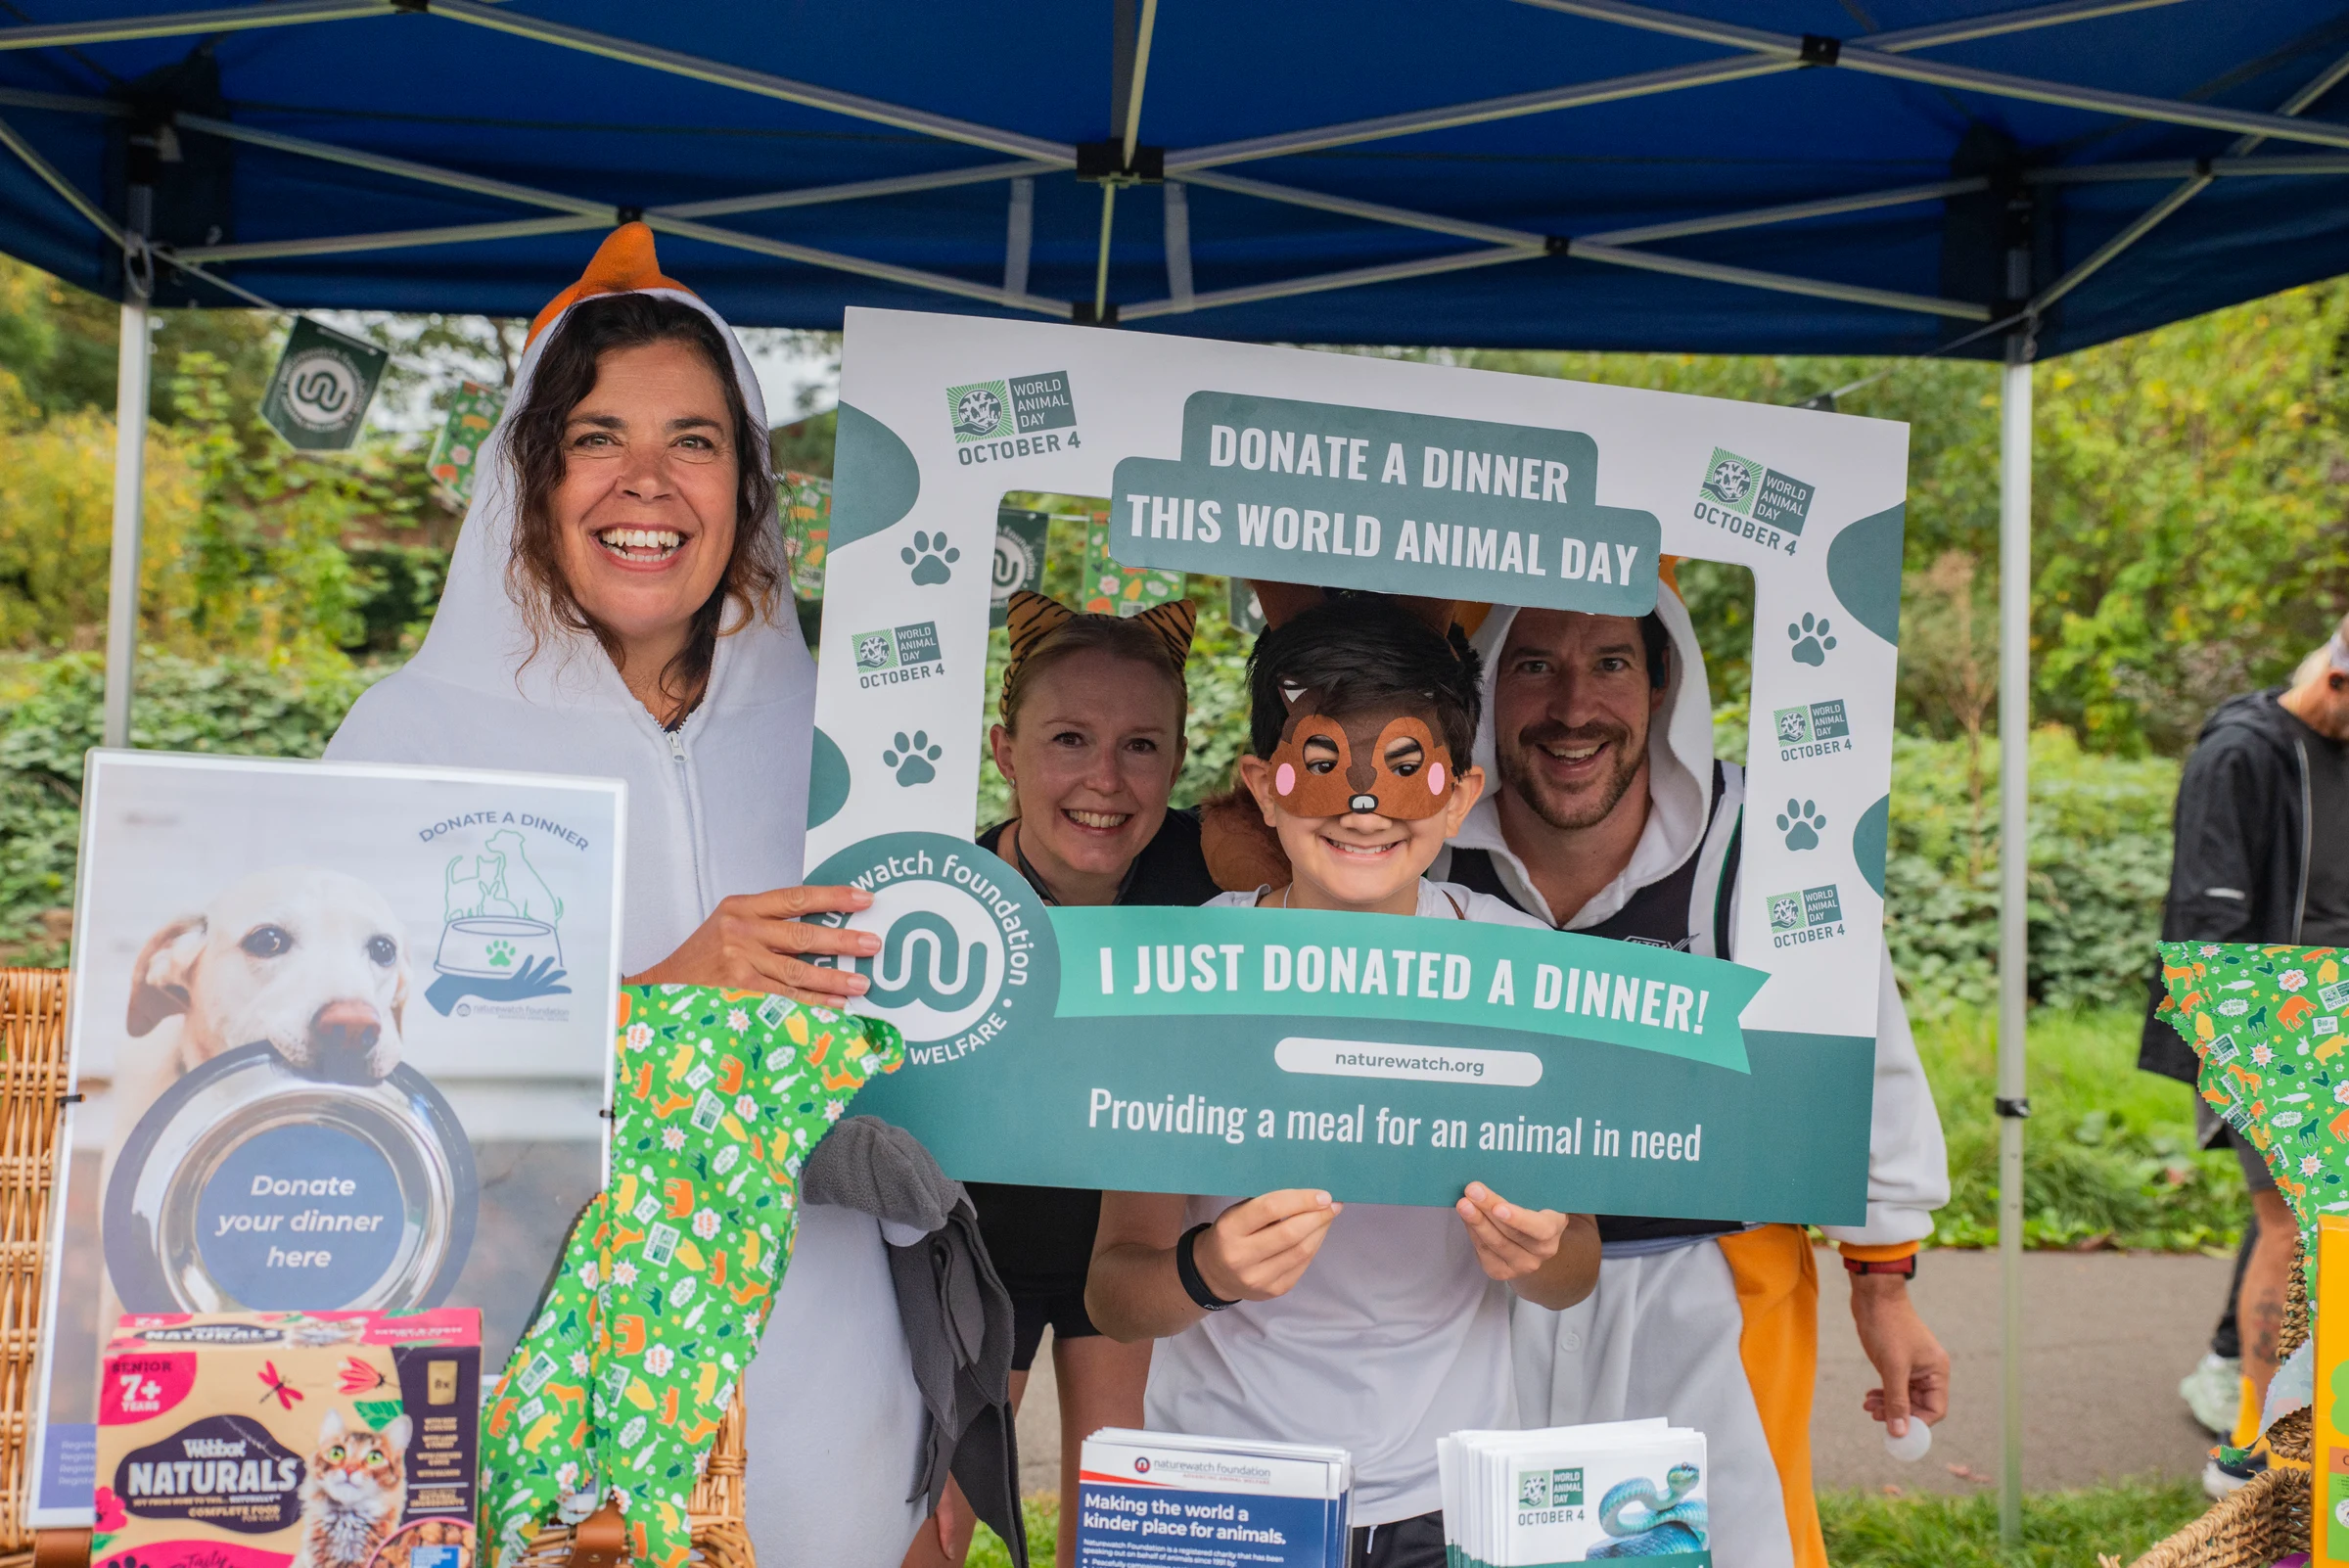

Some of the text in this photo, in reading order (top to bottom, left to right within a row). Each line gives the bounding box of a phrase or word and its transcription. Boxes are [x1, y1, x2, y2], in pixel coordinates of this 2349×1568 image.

[1014, 379, 1061, 396] WORLD
[1018, 394, 1069, 412] ANIMAL
[1021, 413, 1045, 428] DAY
[958, 432, 1081, 465] OCTOBER 4
[1210, 425, 1568, 504] DONATE A DINNER
[1767, 476, 1806, 500] WORLD
[1757, 503, 1780, 521] DAY
[1761, 490, 1804, 516] ANIMAL
[1694, 502, 1797, 556] OCTOBER 4
[1127, 493, 1638, 586] THIS WORLD ANIMAL DAY
[898, 626, 931, 640] WORLD
[900, 638, 936, 651] ANIMAL
[902, 651, 920, 662] DAY
[860, 663, 944, 689] OCTOBER 4
[1813, 705, 1840, 716] WORLD
[1815, 715, 1845, 726] ANIMAL
[1817, 726, 1831, 736] DAY
[1781, 739, 1852, 761] OCTOBER 4
[419, 811, 589, 852] DONATE A DINNER
[1805, 890, 1833, 901] WORLD
[1808, 899, 1838, 912] ANIMAL
[942, 854, 1034, 987] foundation
[1810, 912, 1824, 922] DAY
[1773, 924, 1845, 948] OCTOBER 4
[1100, 944, 1710, 1035] I JUST DONATED A DINNER!
[910, 1012, 1007, 1065] WELFARE
[1335, 1050, 1485, 1077] naturewatch.org
[1088, 1087, 1701, 1163] Providing a meal for an animal in need
[251, 1175, 356, 1196] Donate
[215, 1209, 383, 1236] your dinner
[266, 1246, 332, 1268] here
[112, 1361, 171, 1372] SENIOR
[120, 1374, 161, 1401] 7+
[122, 1402, 160, 1411] YEARS
[128, 1457, 298, 1496] NATURALS
[1154, 1459, 1270, 1476] naturewatch foundation
[1553, 1472, 1580, 1483] WORLD
[1553, 1482, 1582, 1493] ANIMAL
[1084, 1493, 1249, 1522] Making the world a
[1554, 1494, 1568, 1503] DAY
[188, 1506, 251, 1517] COMPLETE
[1518, 1509, 1585, 1527] OCTOBER 4
[1083, 1511, 1286, 1545] kinder place for animals.
[1083, 1539, 1126, 1548] Naturewatch
[1127, 1542, 1166, 1552] Foundation
